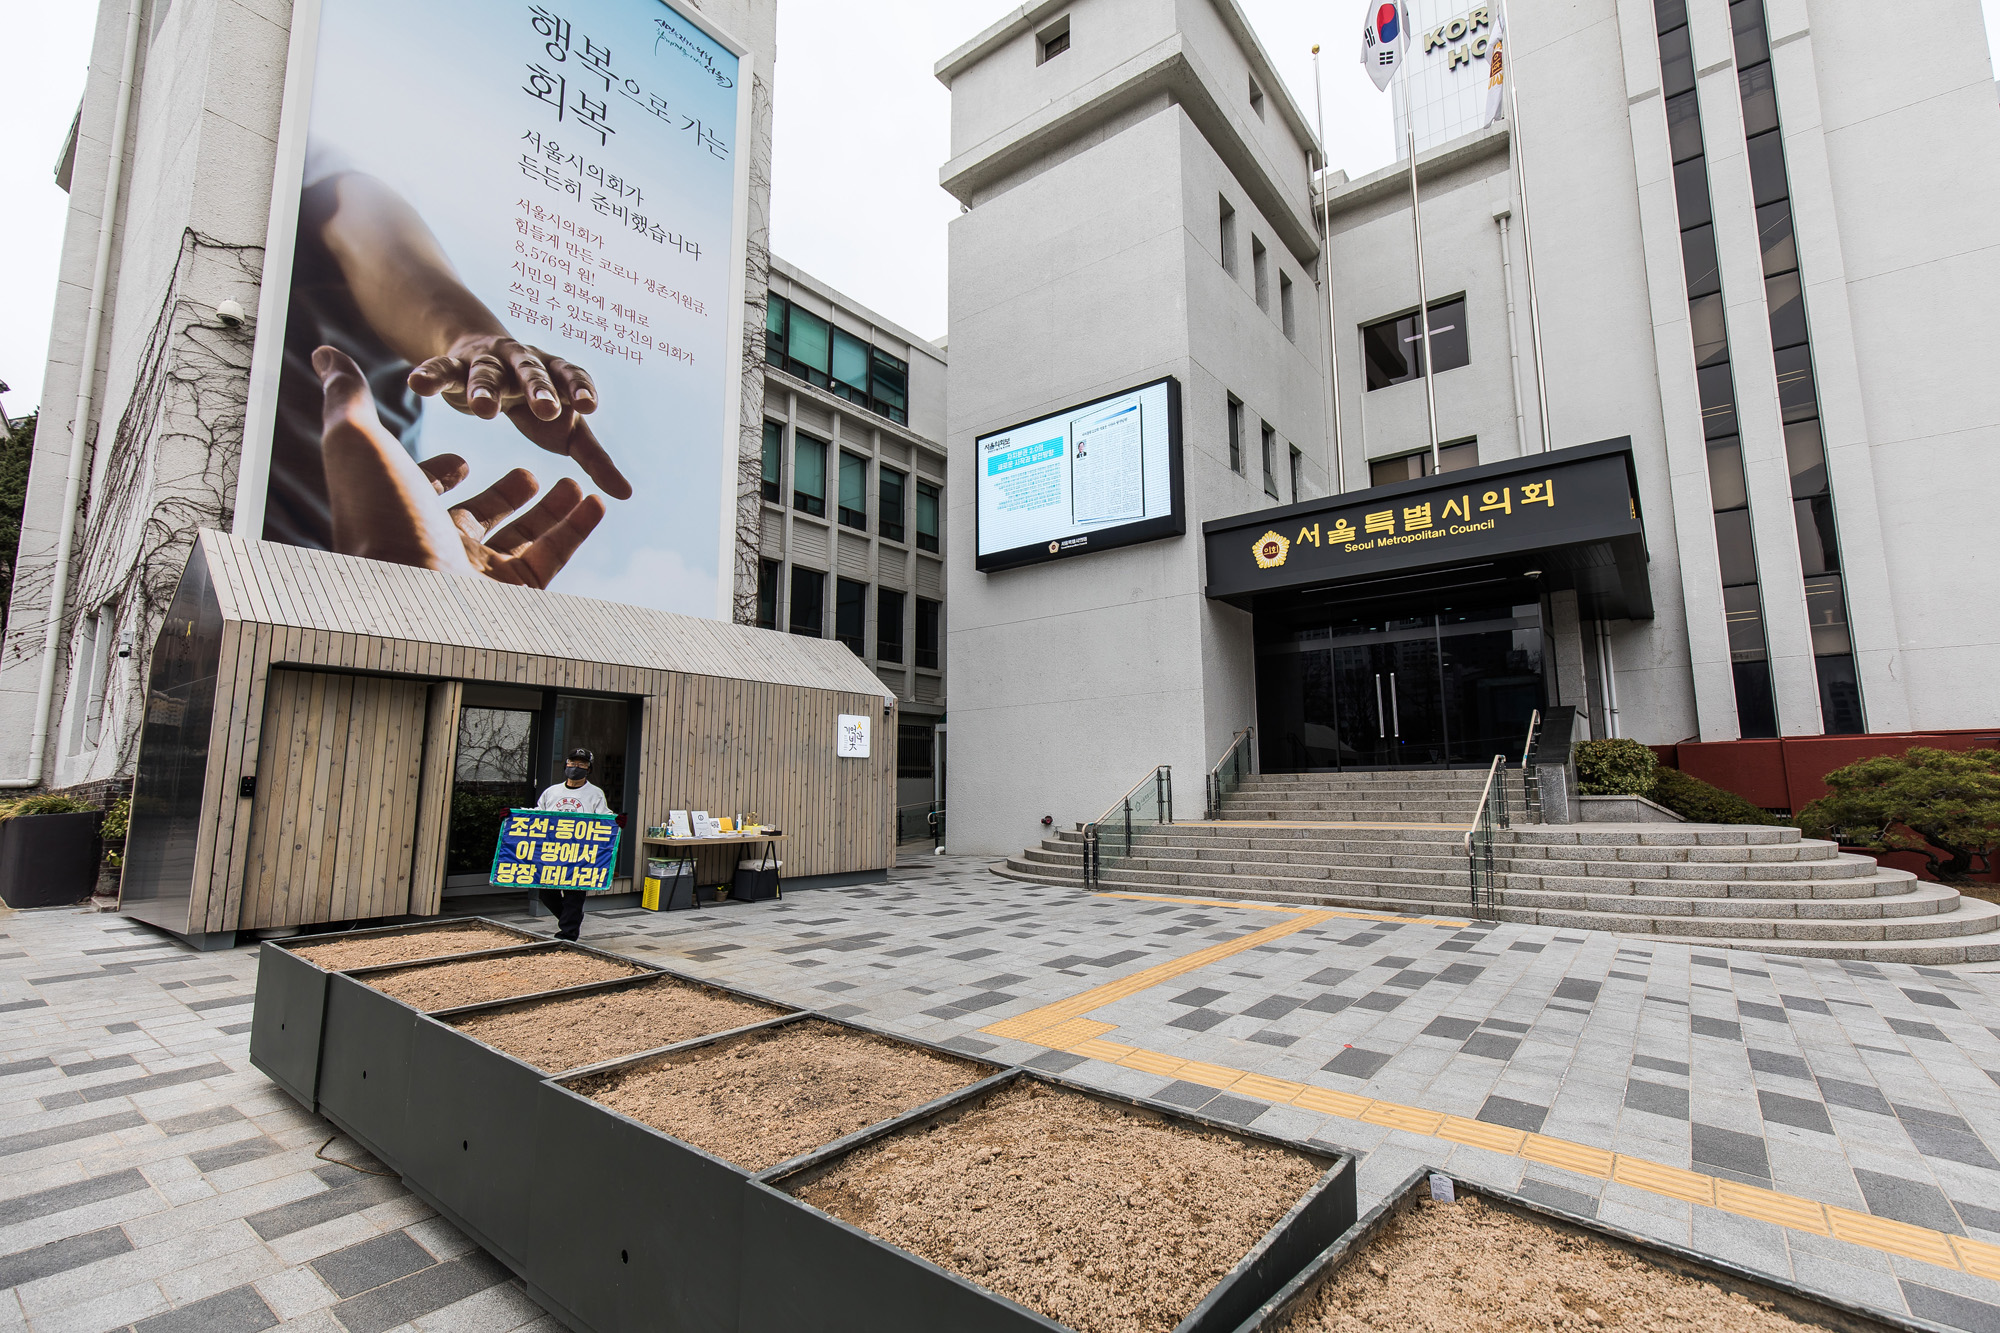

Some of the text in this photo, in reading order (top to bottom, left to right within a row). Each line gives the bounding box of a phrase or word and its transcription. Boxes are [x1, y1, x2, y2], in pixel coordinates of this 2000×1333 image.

[521, 63, 616, 147] 회복
[528, 5, 671, 124] 행복으로
[681, 114, 729, 160] 가는
[520, 128, 644, 207] 서울시의회가
[516, 198, 605, 250] 서울시의회가
[517, 153, 702, 261] 든든히 준비했습니다
[514, 217, 560, 250] 힘들게
[565, 241, 595, 265] 만든
[598, 258, 639, 285] 코로나
[576, 267, 596, 287] 원!
[508, 281, 695, 366] 쓰일 수 있도록 당신의 의회가
[511, 260, 650, 328] 시민의 회복에 제대로
[507, 300, 644, 365] 꼼꼼히 살피겠습니다
[1296, 479, 1555, 548] 서울특별시의회
[1344, 518, 1495, 553] Seoul Metropolitan Council
[1263, 544, 1279, 555] 의회
[496, 862, 608, 888] 당장 떠나라!
[515, 840, 599, 864] 이 땅에서
